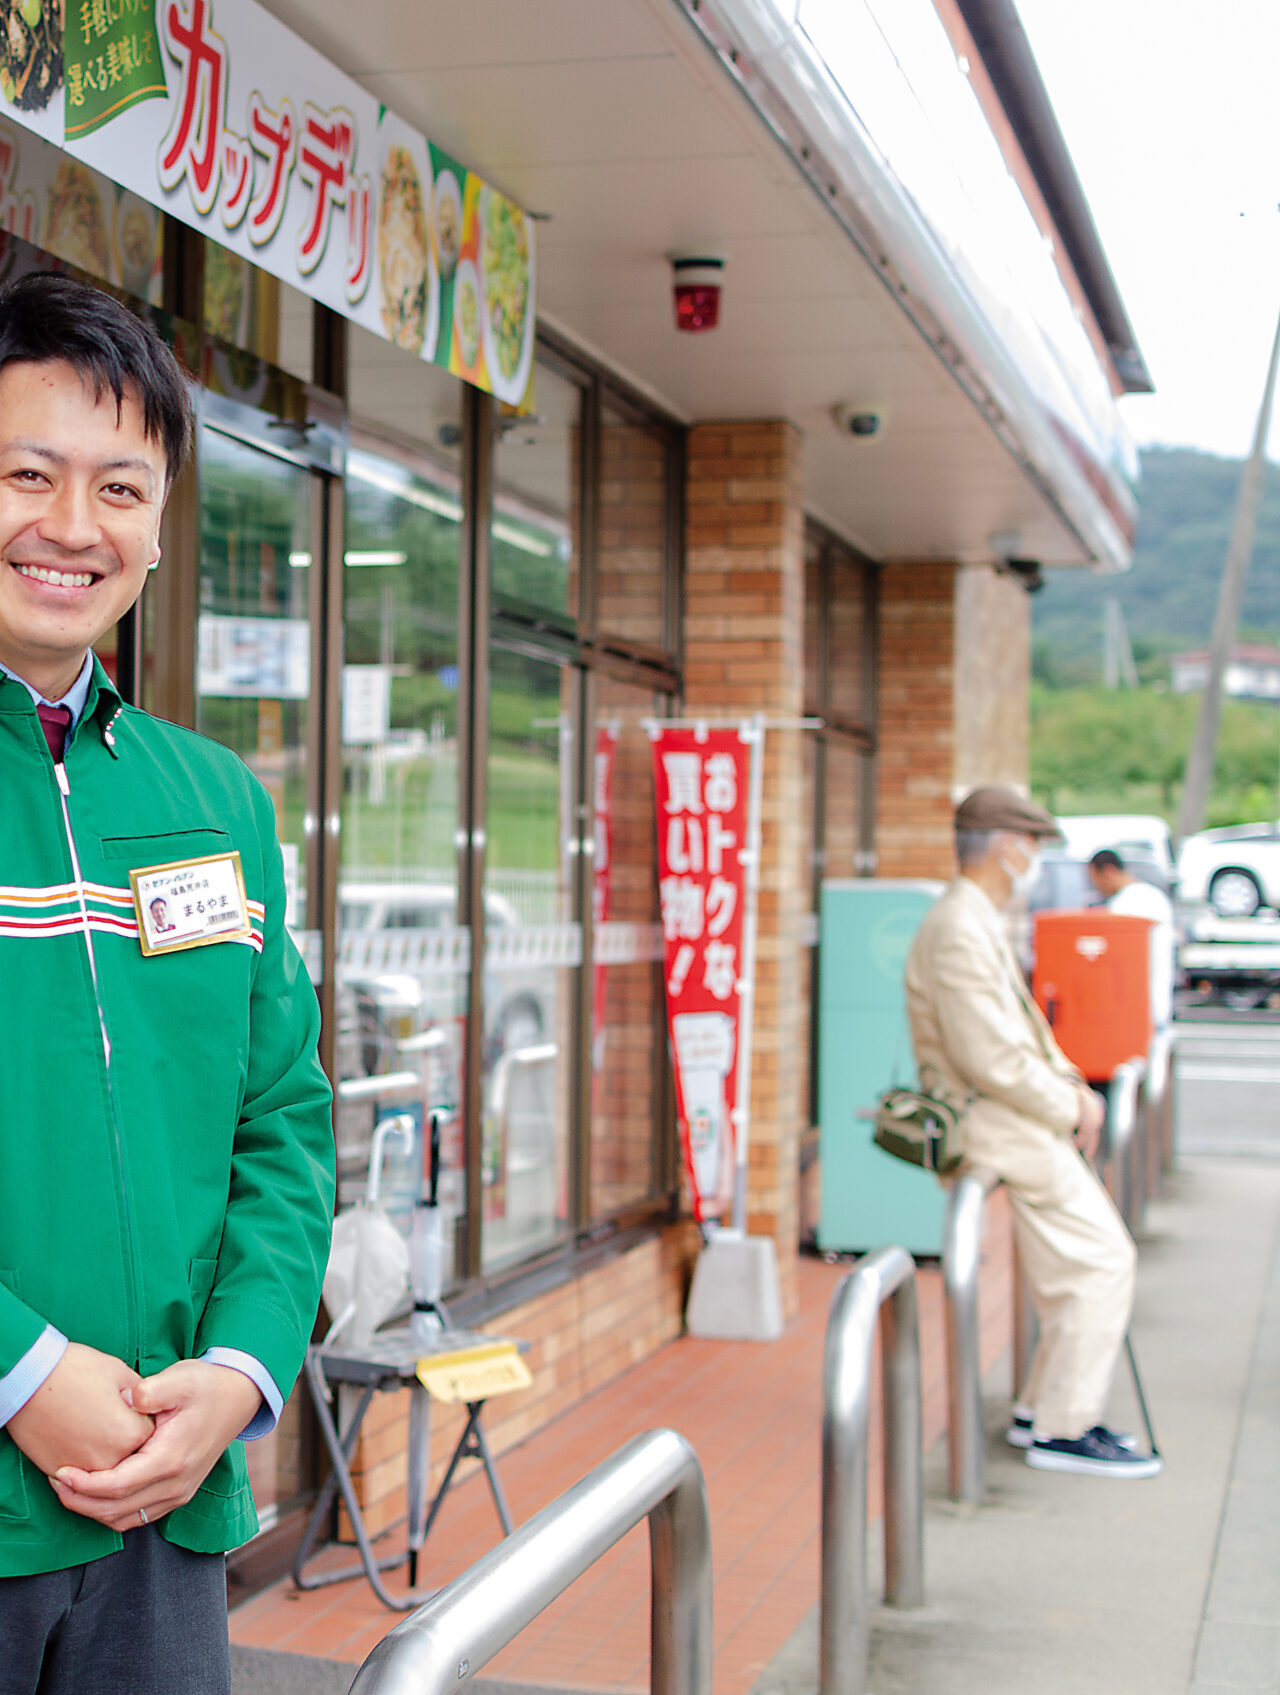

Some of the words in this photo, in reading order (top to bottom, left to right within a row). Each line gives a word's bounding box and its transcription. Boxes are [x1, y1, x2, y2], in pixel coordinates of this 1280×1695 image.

[67, 31, 153, 106] 選べる美味しさ
[161, 0, 371, 290] カップデリ
[183, 896, 229, 917] まるやま
[704, 750, 738, 1000] おトクな
